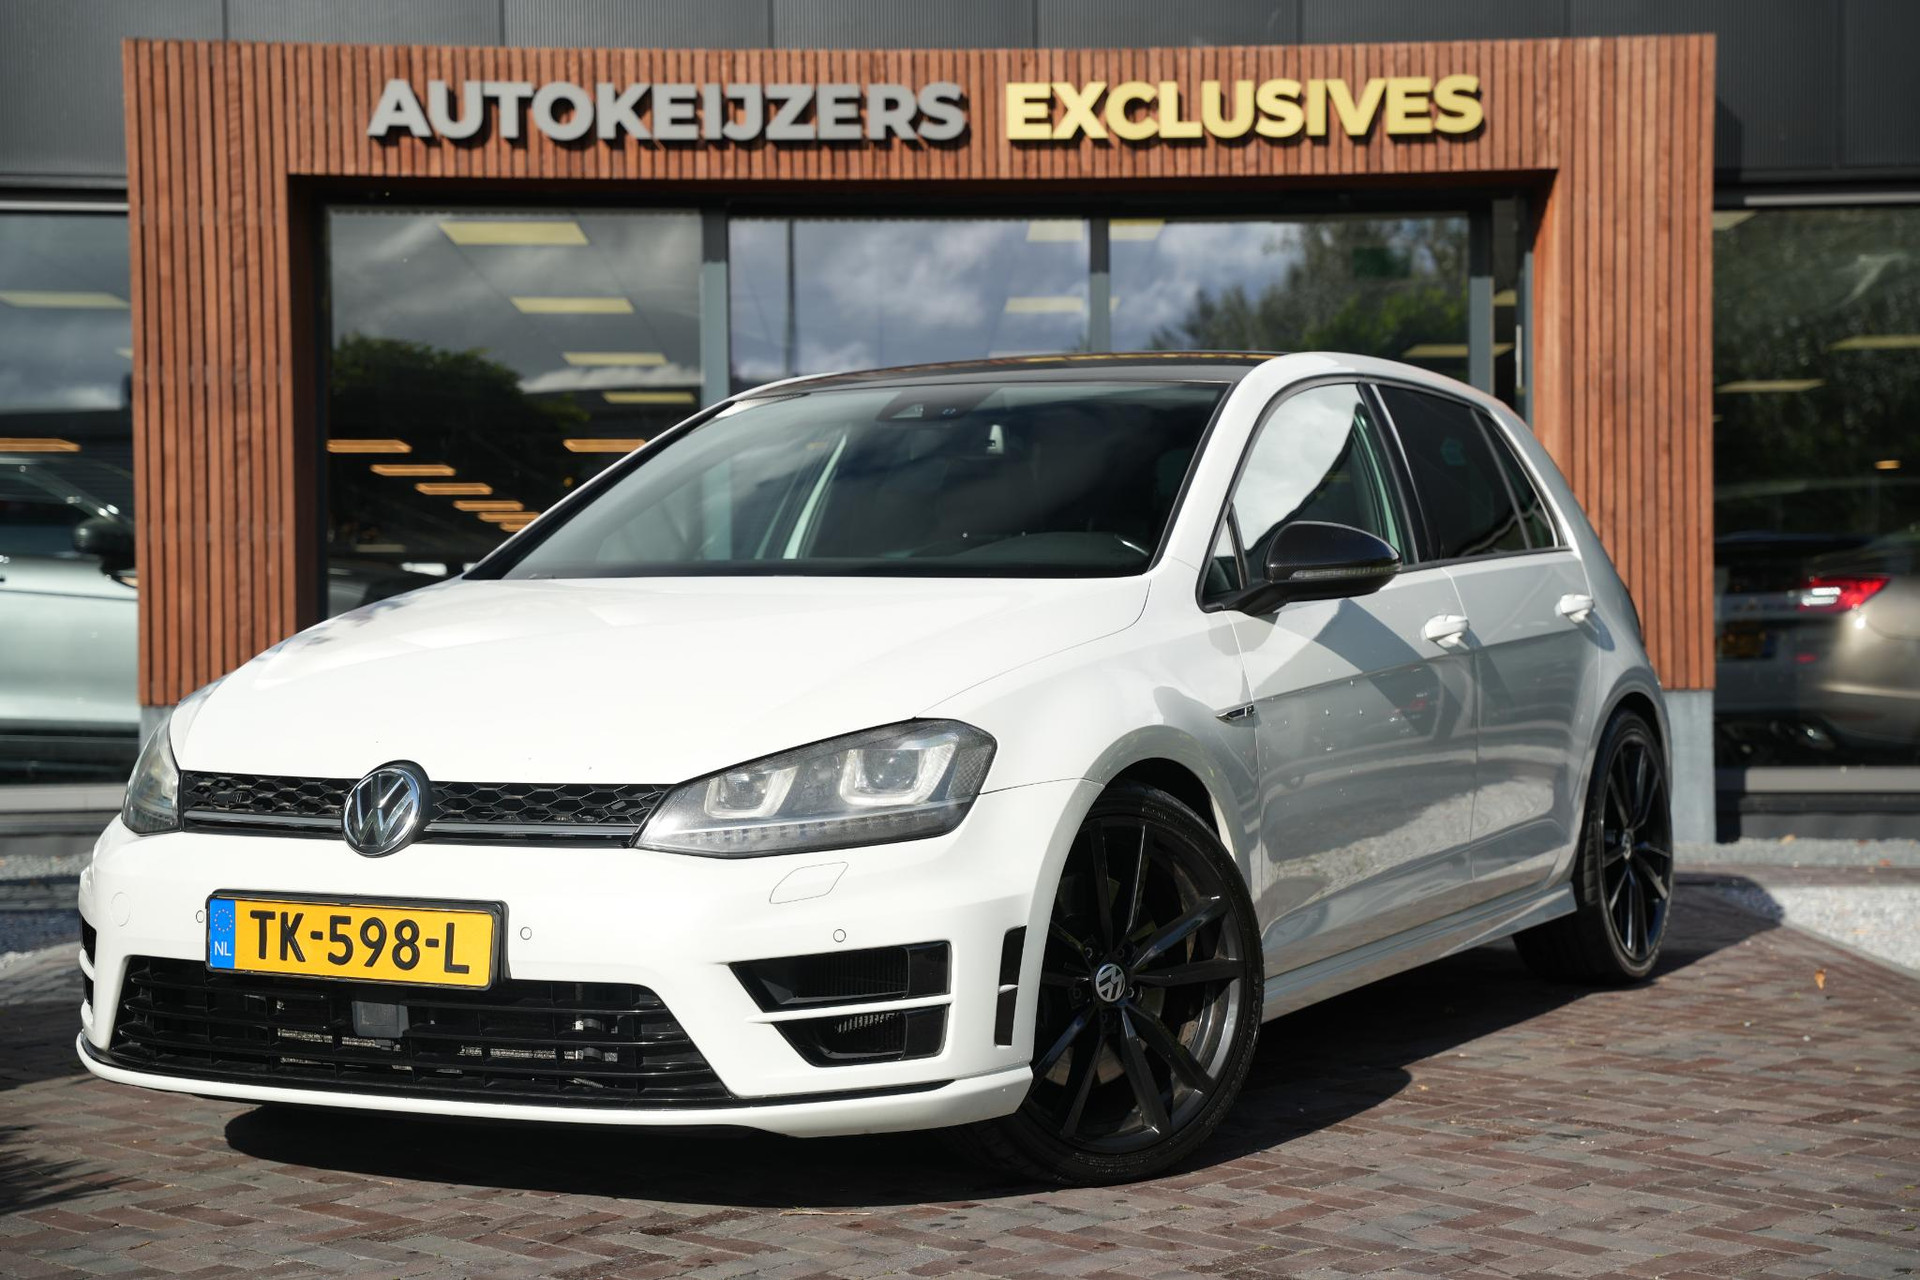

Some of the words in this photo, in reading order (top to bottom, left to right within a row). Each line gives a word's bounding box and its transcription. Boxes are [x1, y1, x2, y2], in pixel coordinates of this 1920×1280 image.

[367, 78, 968, 141] AUTOKEIJZERS
[1005, 74, 1484, 141] EXCLUSIVES
[213, 940, 232, 957] NL
[249, 909, 471, 975] TK-598-L
